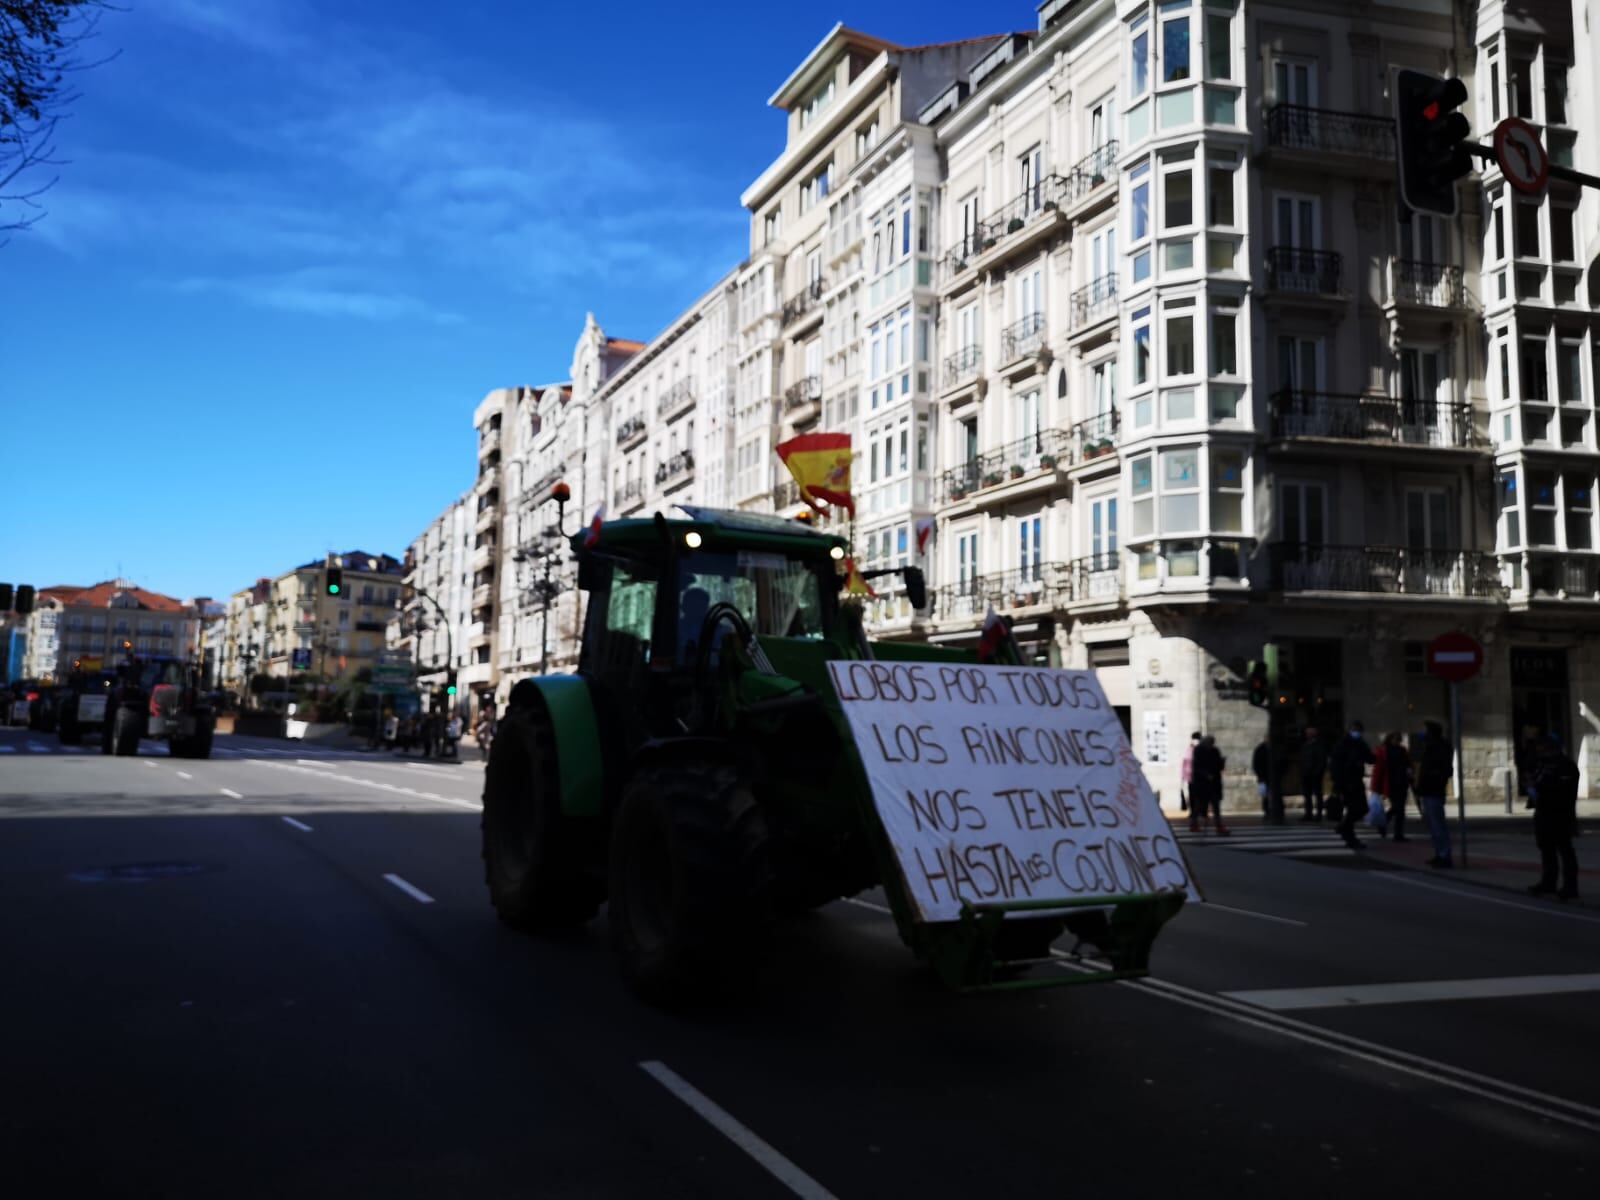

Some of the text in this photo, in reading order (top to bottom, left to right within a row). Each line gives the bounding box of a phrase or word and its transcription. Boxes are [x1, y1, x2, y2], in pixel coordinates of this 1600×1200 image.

[830, 661, 1101, 710] LOBOS POR TODOS
[872, 723, 949, 764] LOS
[906, 788, 987, 832] NOS
[914, 842, 1032, 904] HASTA
